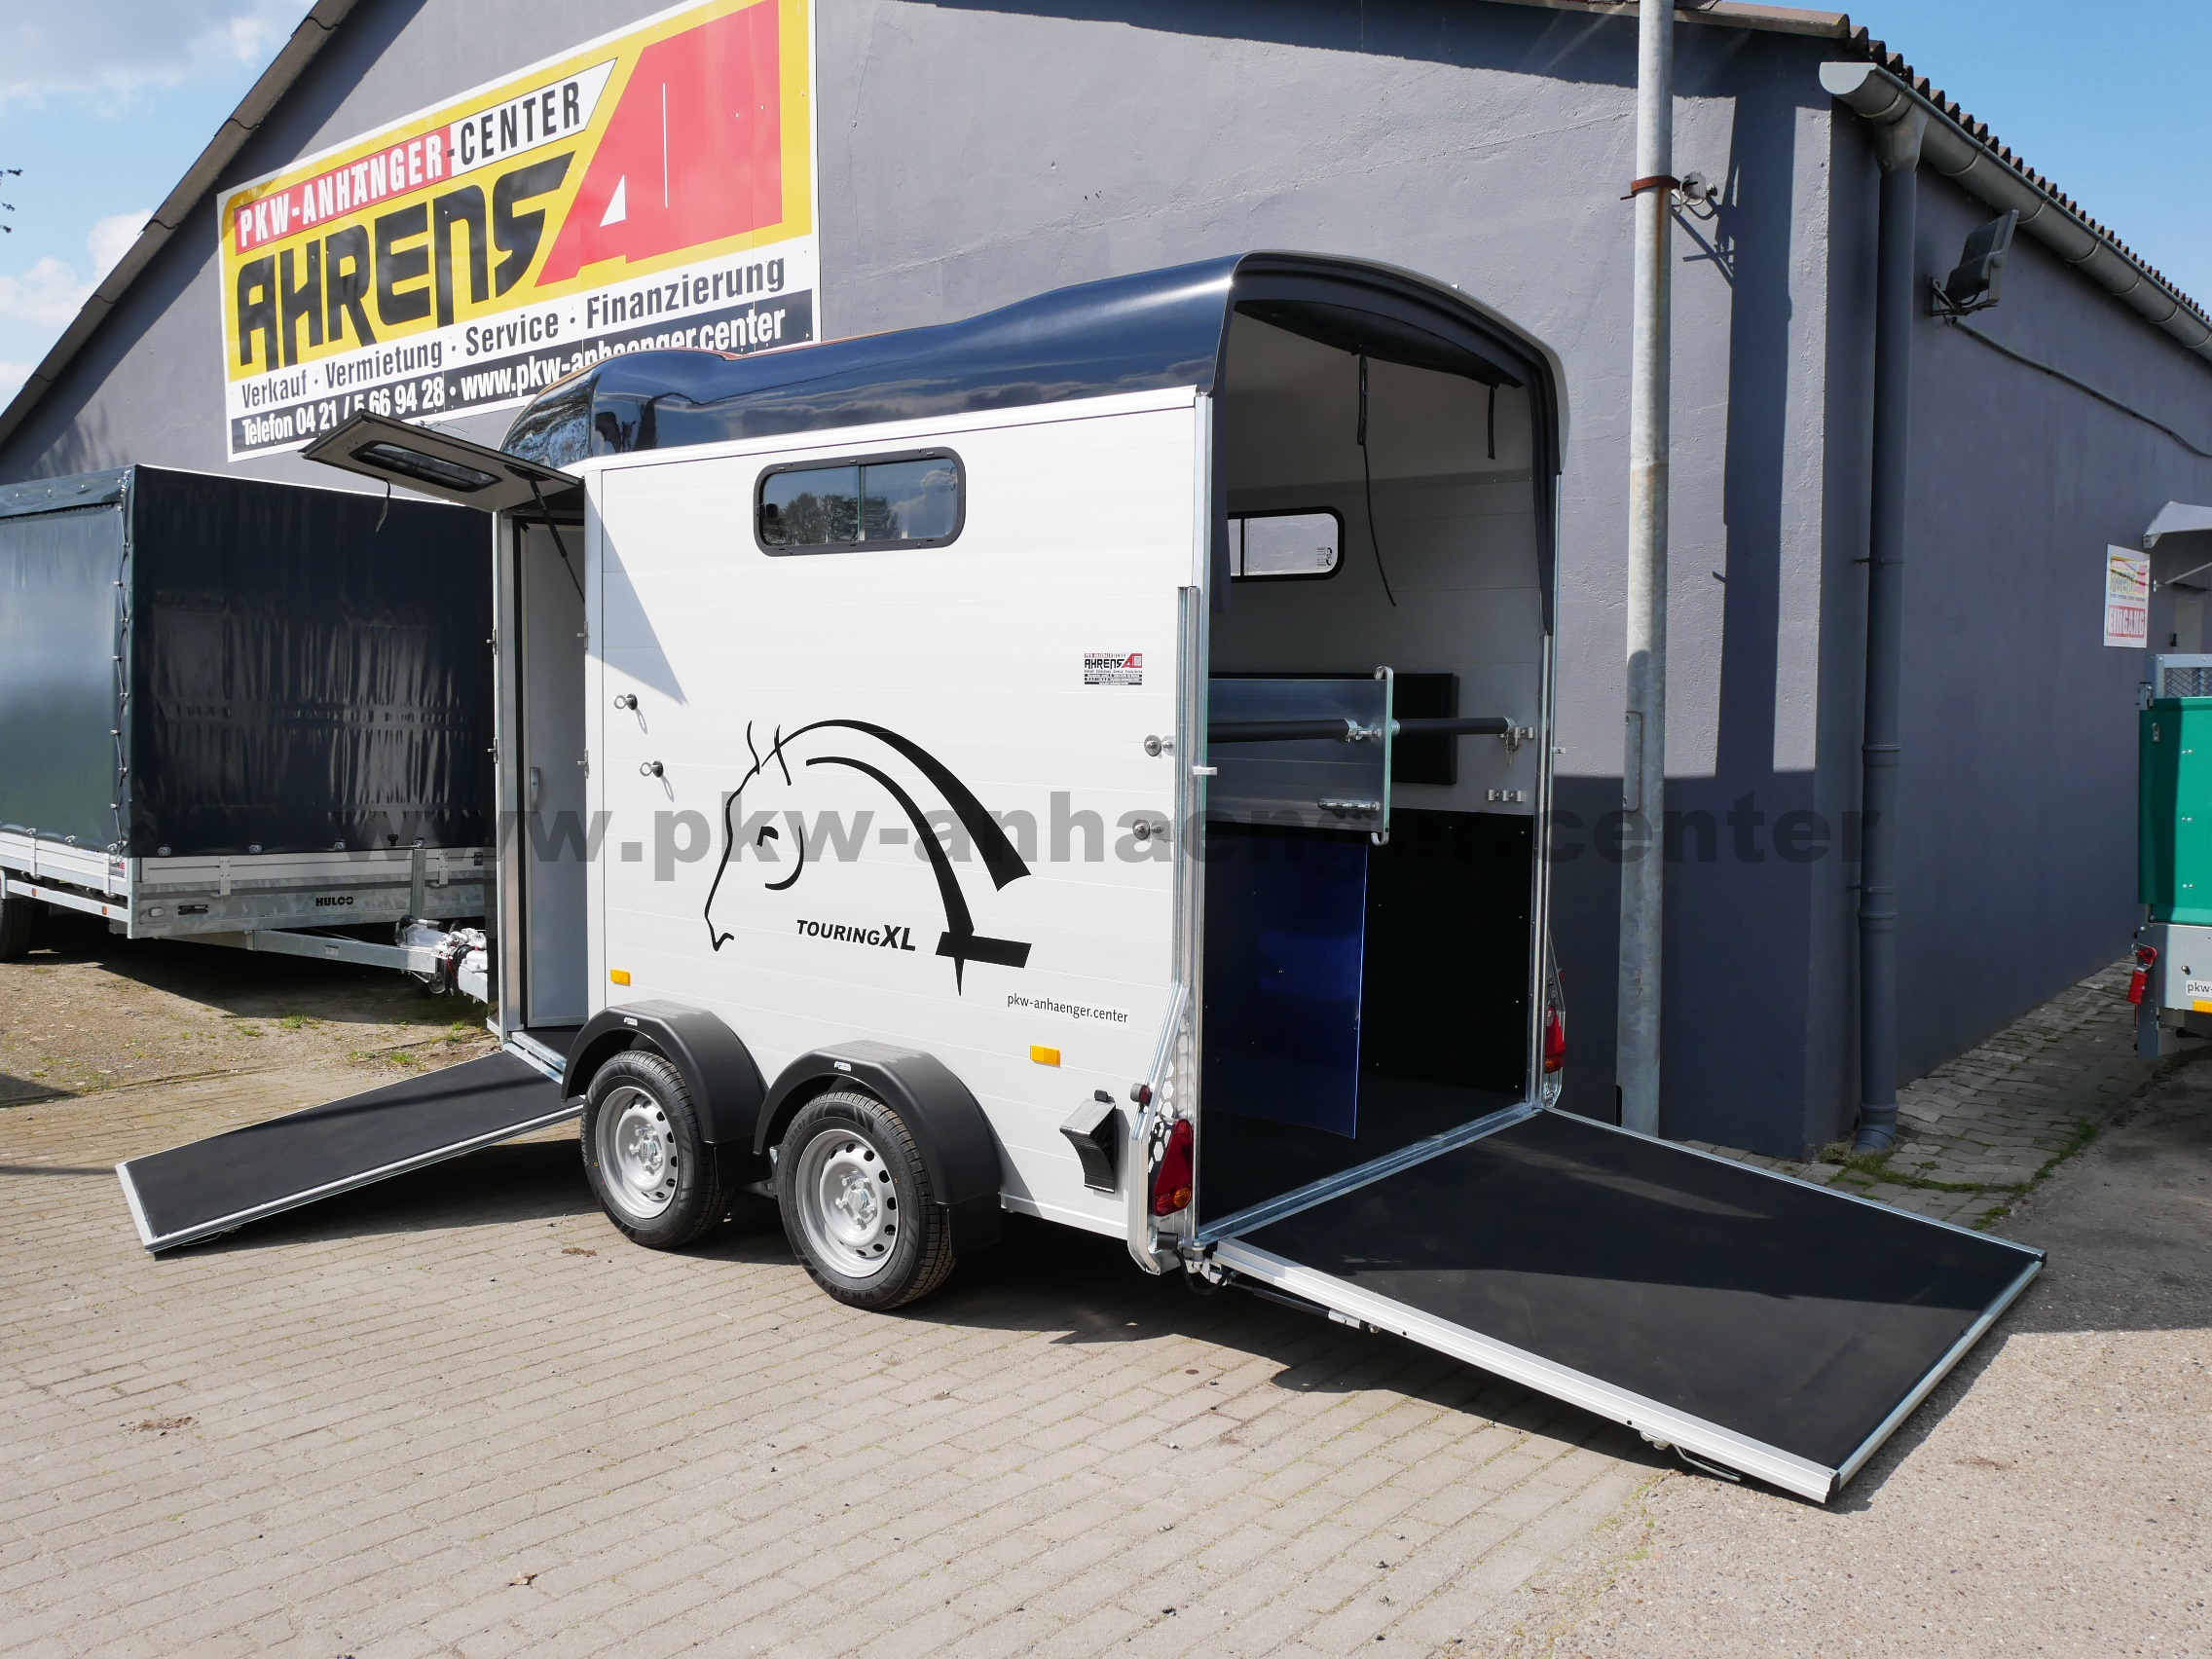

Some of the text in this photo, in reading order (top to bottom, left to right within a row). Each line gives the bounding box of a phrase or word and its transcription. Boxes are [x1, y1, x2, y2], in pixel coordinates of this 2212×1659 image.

[237, 150, 576, 373] AHRENS
[241, 256, 785, 410] Verkauf Vermietung Service Finanzierung
[242, 412, 294, 447] Telefon
[295, 404, 316, 436] 04
[318, 399, 338, 431] 21
[368, 387, 390, 417] 66
[394, 383, 418, 416] 94
[422, 375, 446, 410] 28
[2108, 607, 2146, 636] EINGANG
[315, 896, 354, 907] HULCO
[1007, 992, 1128, 1023] pkw-anhaenger.center
